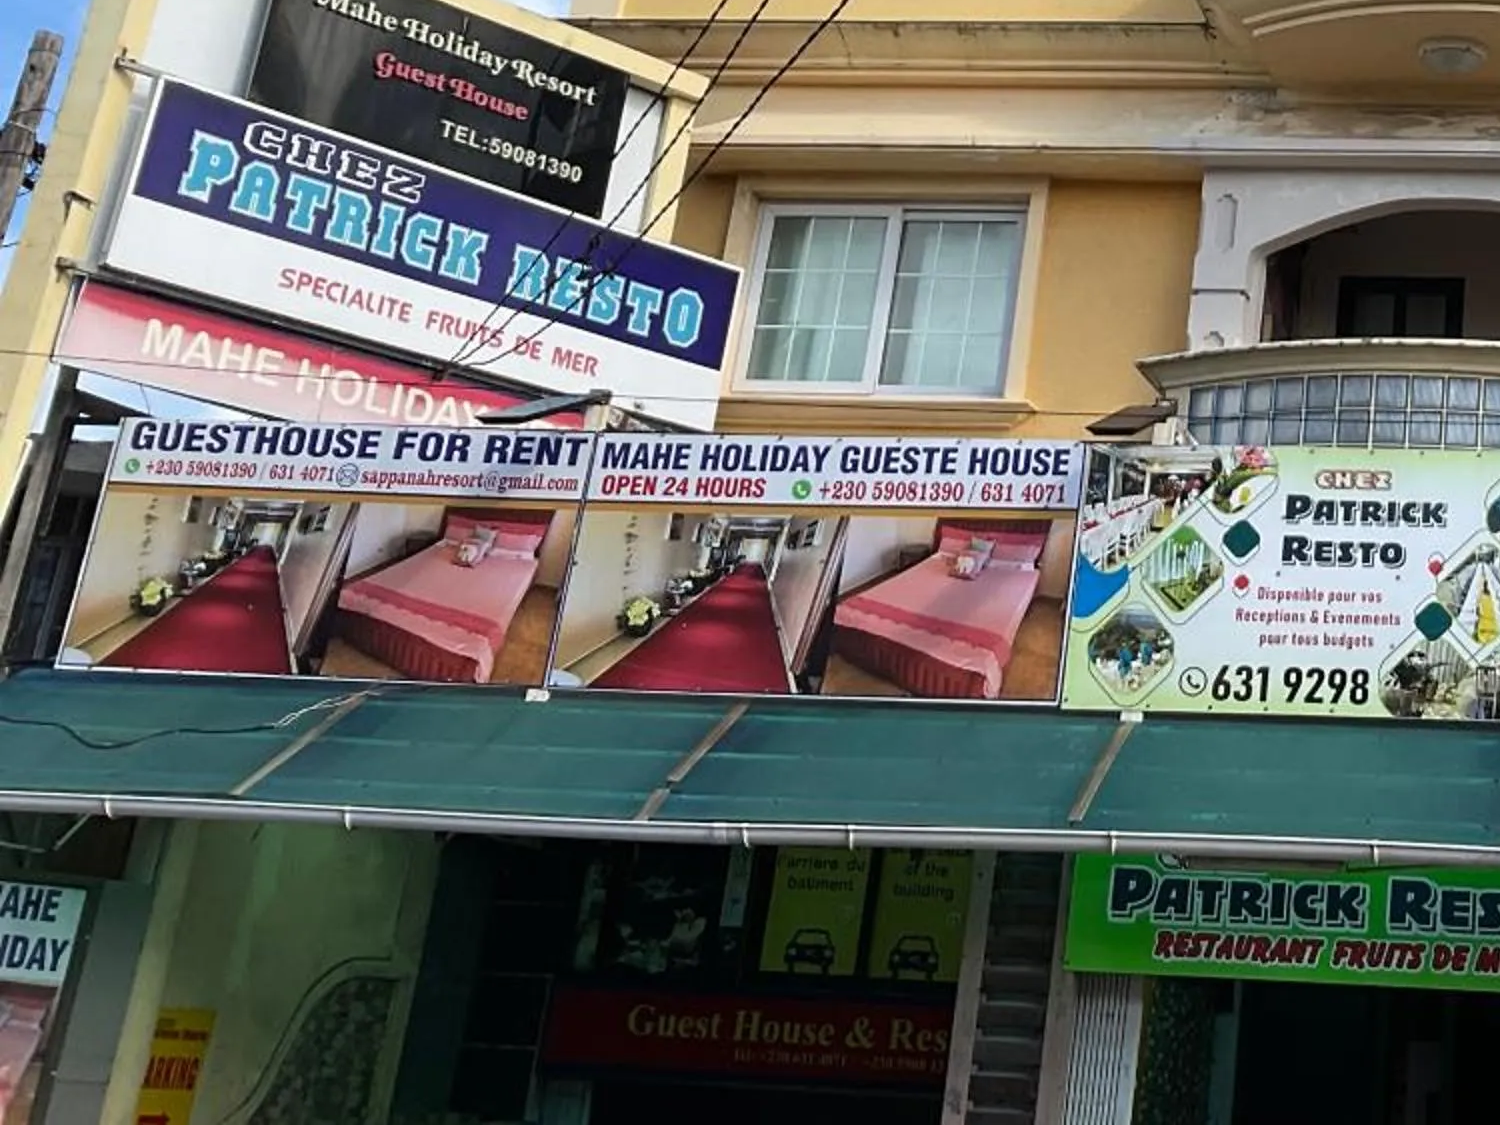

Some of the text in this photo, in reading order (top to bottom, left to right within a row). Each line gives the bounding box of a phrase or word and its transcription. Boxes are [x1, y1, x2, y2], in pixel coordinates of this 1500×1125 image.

[401, 17, 511, 75] Holiday
[511, 57, 598, 106] Resort
[375, 51, 529, 122] Guest House
[241, 120, 427, 204] CHEZ
[439, 119, 583, 183] TEL:59081390
[178, 130, 704, 348] PATRICK RESTO
[278, 268, 599, 377] SPECIALITE FRUITS DE MER
[141, 318, 285, 388] MAHE
[130, 420, 588, 467] GUESTHOUSE FOR RENT
[601, 442, 1070, 476] MAHE HOLIDAY GUESTE HOUSE
[145, 461, 183, 477] +230
[186, 462, 257, 479] 59081390
[268, 464, 296, 480] 631
[300, 465, 334, 482] 4071
[601, 475, 656, 496] OPEN
[663, 476, 689, 497] 24
[695, 477, 767, 499] HOURS
[818, 481, 866, 502] +230
[871, 482, 963, 503] 59081390
[980, 483, 1014, 503] 631
[1020, 484, 1065, 504] 4071
[1315, 470, 1393, 490] CHEZ
[1282, 494, 1447, 528] PATRICK
[1281, 534, 1407, 569] RESTO
[1257, 586, 1324, 603] Disponible
[1328, 588, 1356, 605] pour
[1310, 610, 1319, 623] &
[1259, 632, 1374, 649] pour tous budgets
[1211, 664, 1369, 705] 631 9298
[0, 884, 62, 922] AHE
[1107, 866, 1369, 929] PATRICK
[1154, 929, 1323, 965] RESTAURANT
[1331, 937, 1426, 971] FRUITS
[1431, 942, 1470, 973] DE
[626, 1002, 949, 1054] Guest House & Res
